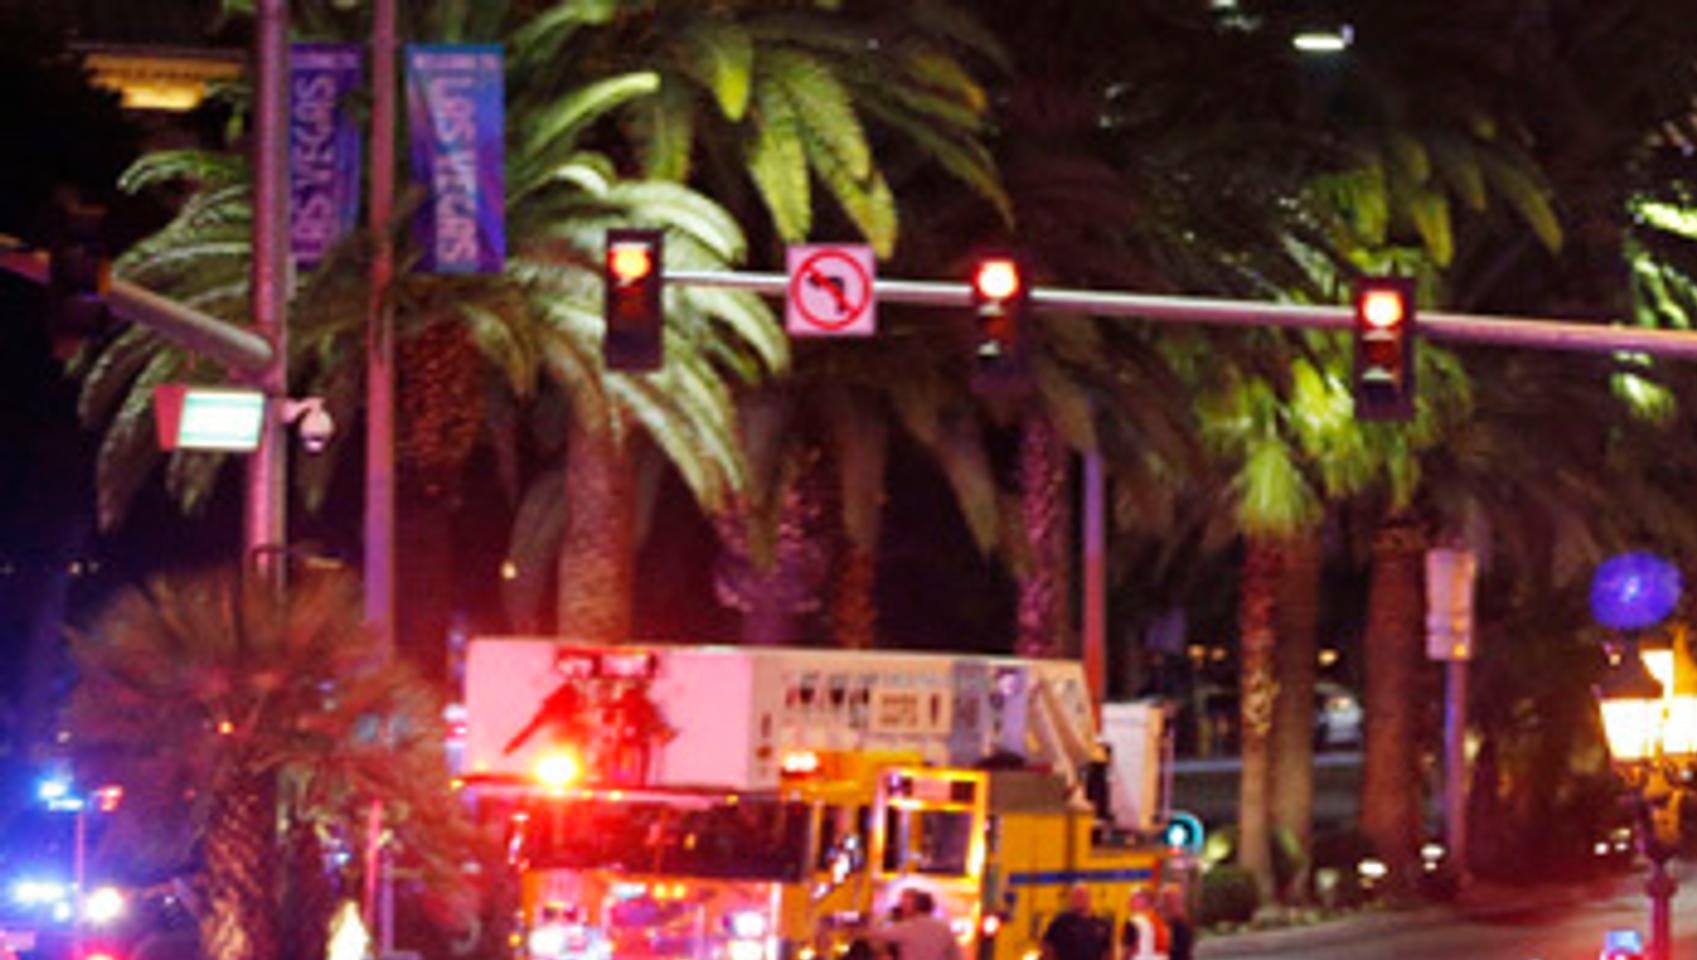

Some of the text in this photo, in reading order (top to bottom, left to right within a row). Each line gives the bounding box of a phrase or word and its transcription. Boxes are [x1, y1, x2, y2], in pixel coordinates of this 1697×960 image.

[293, 75, 337, 189] VEGAS
[431, 75, 476, 142] LAS
[433, 148, 479, 263] VEGAS
